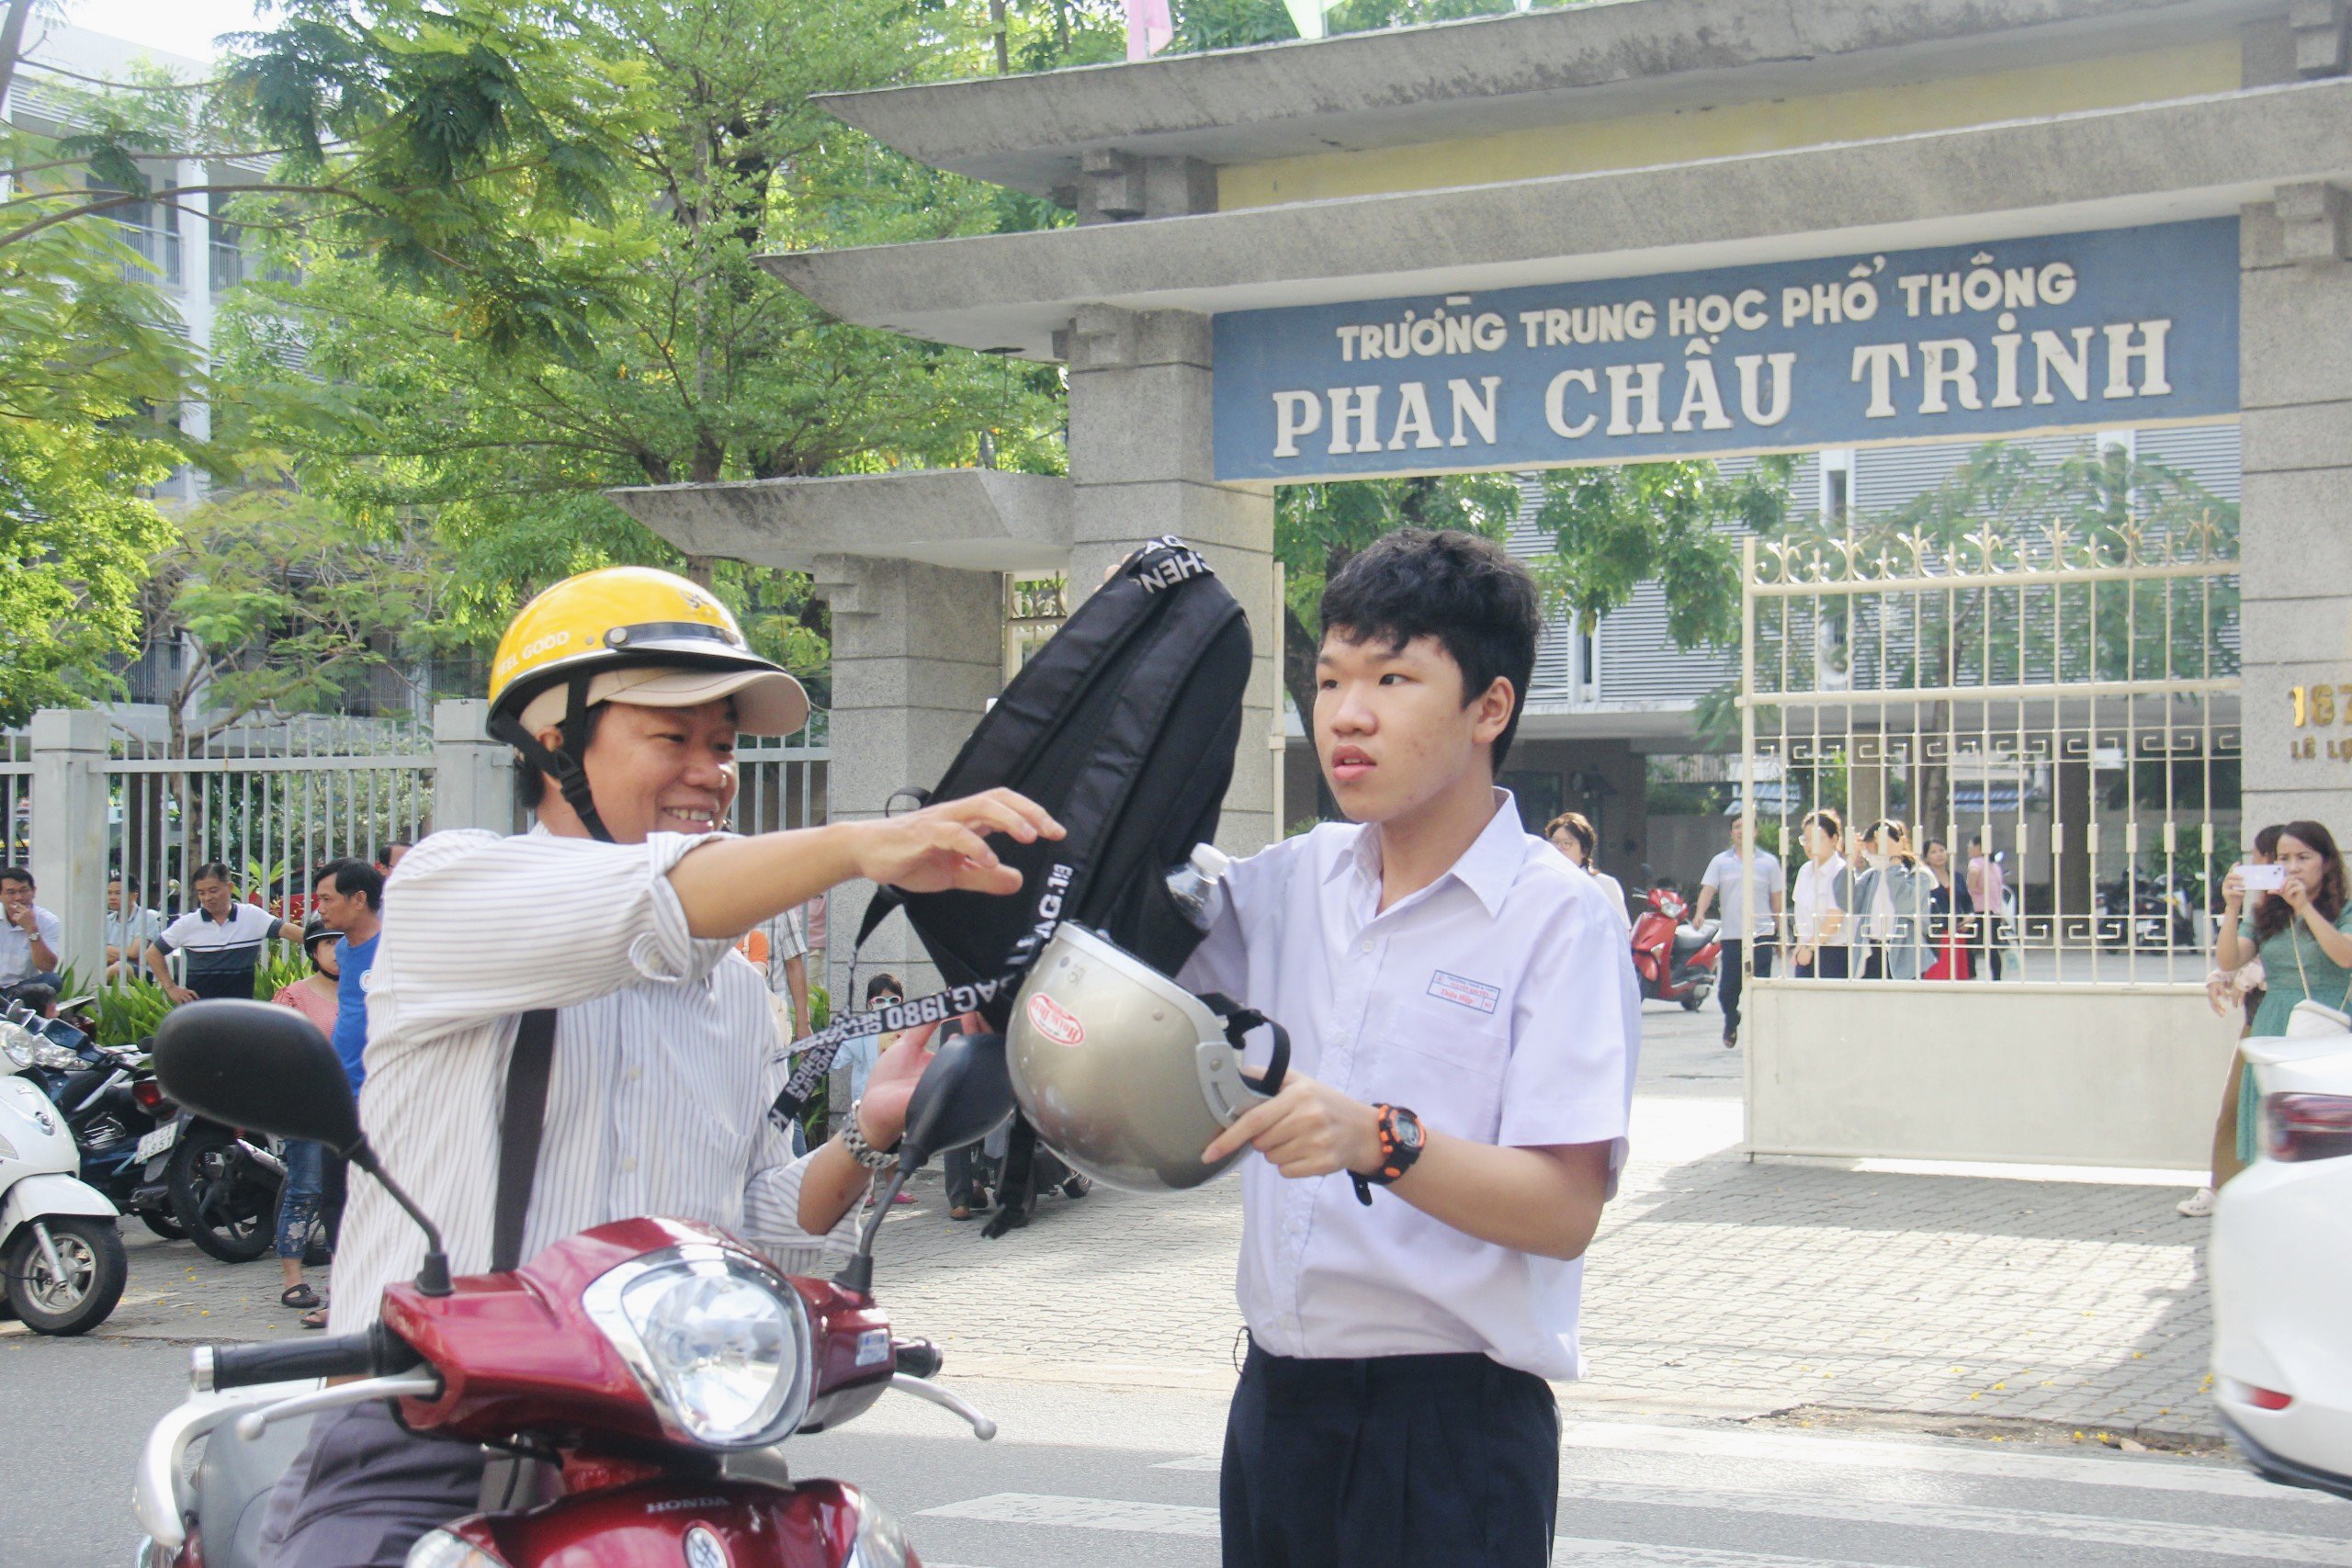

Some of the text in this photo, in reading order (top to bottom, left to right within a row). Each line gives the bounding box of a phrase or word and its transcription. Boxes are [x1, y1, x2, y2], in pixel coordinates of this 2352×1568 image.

[1519, 299, 1657, 348] TRUNG
[1668, 288, 1770, 344] HỌC
[1781, 255, 1887, 328] PHỔ
[1898, 251, 2077, 317] THÔNG
[1272, 376, 1502, 458] PHAN
[1544, 337, 1797, 438] CHÂU
[521, 630, 570, 660] GOOD
[646, 1496, 731, 1515] HONDA
